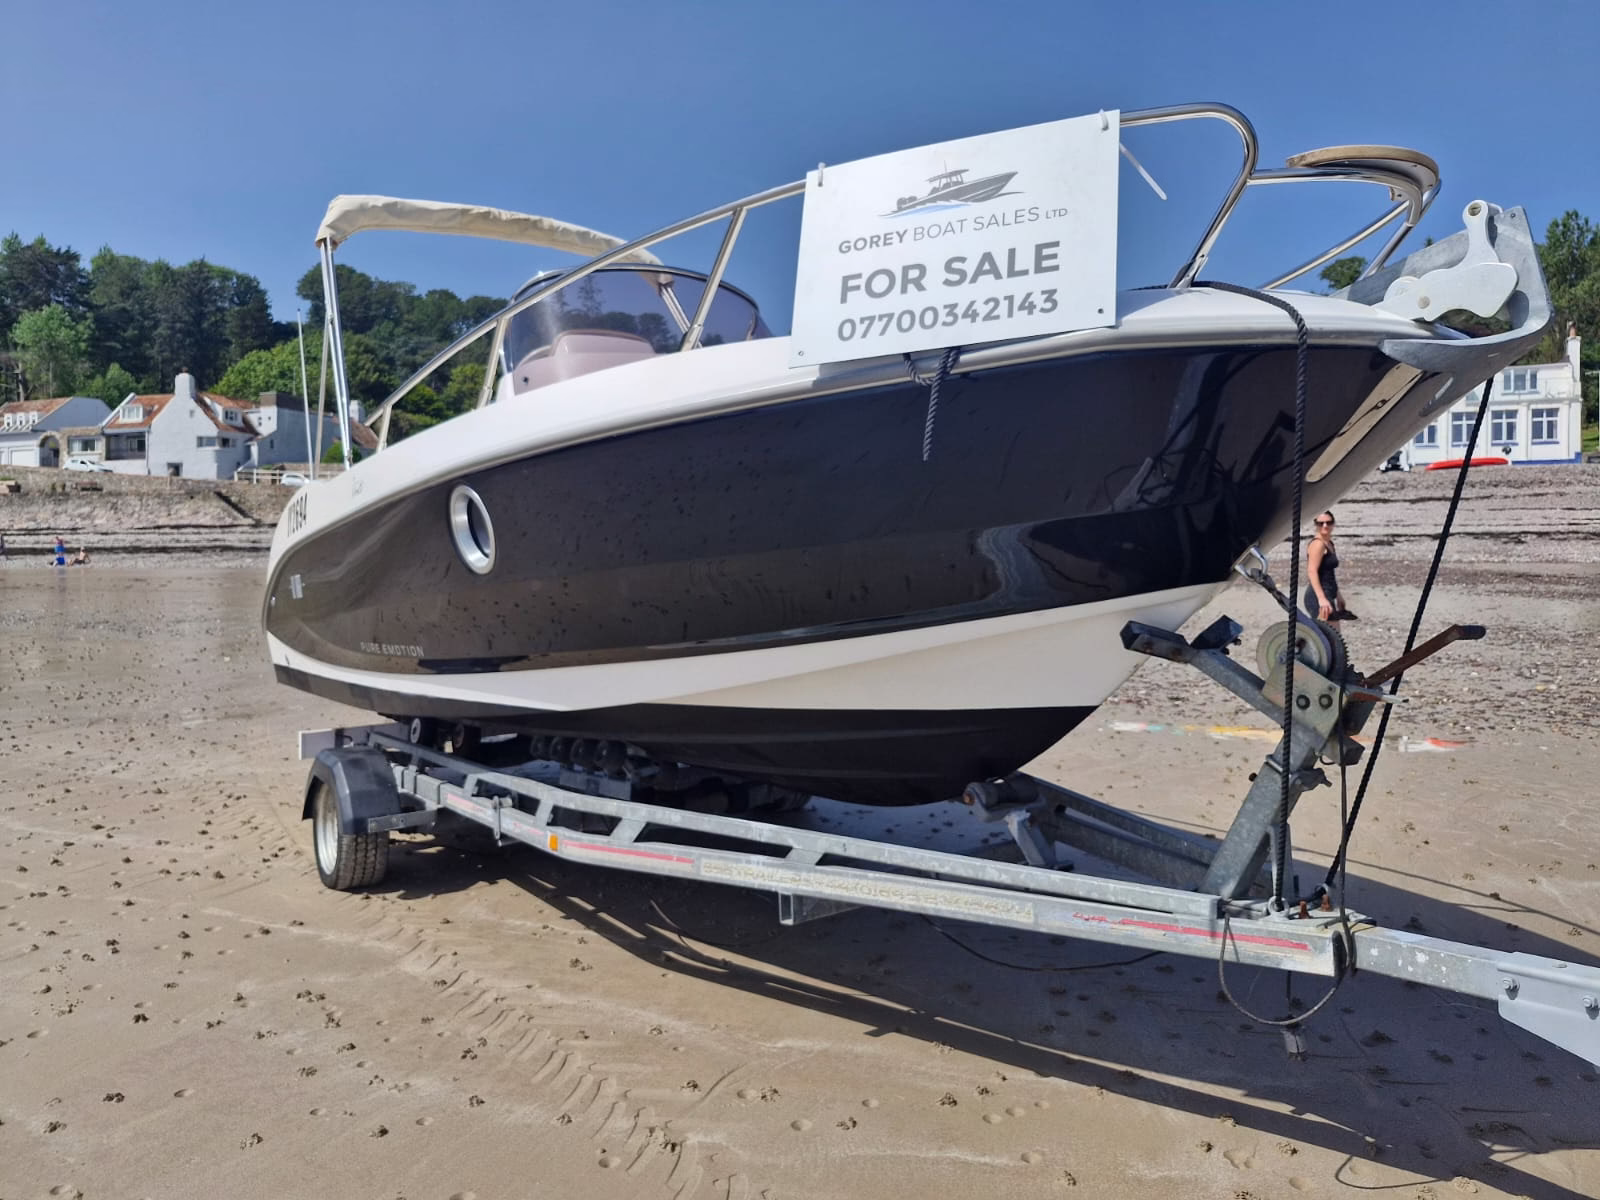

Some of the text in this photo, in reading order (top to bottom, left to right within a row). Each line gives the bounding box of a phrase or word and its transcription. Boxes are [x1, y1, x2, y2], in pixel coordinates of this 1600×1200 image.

[838, 206, 1068, 254] GOREY BOAT SALES LTD
[840, 240, 1060, 305] FOR SALE
[837, 288, 1059, 342] 07700342143
[360, 641, 425, 657] PURE EMOTION
